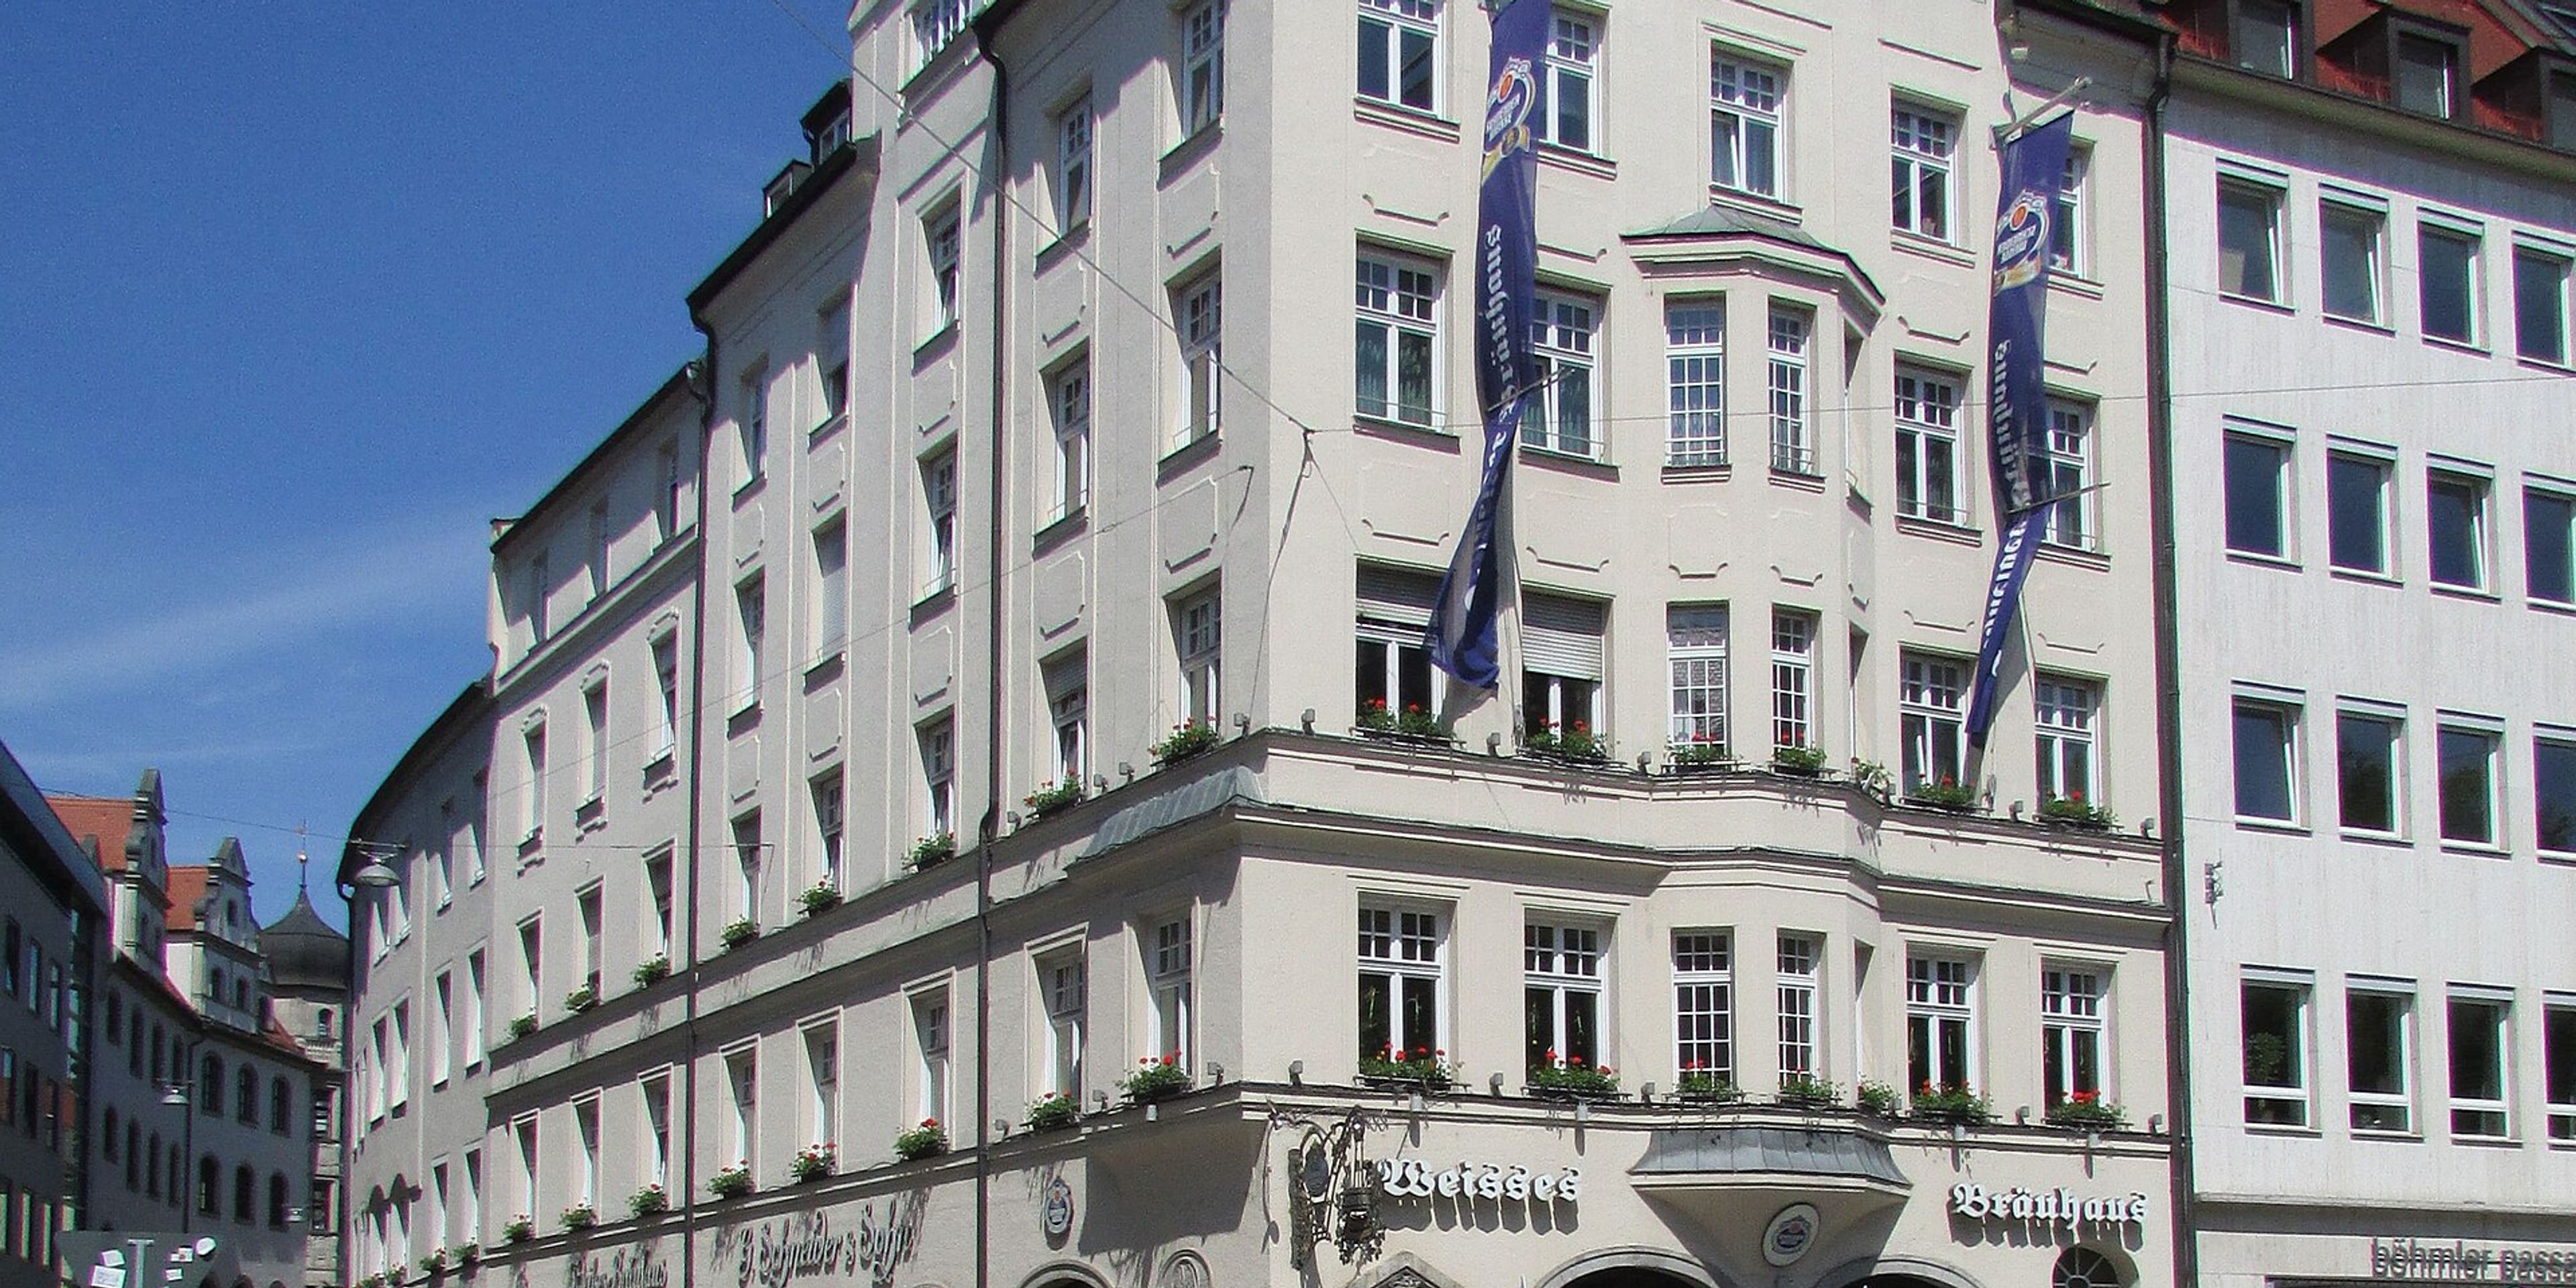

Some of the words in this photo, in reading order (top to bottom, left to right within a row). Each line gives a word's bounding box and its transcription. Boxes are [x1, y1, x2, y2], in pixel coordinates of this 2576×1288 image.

[1377, 1159, 1579, 1201] Weisses
[1947, 1183, 2146, 1229] Bräuhaus
[2371, 1237, 2490, 1274] böhmler
